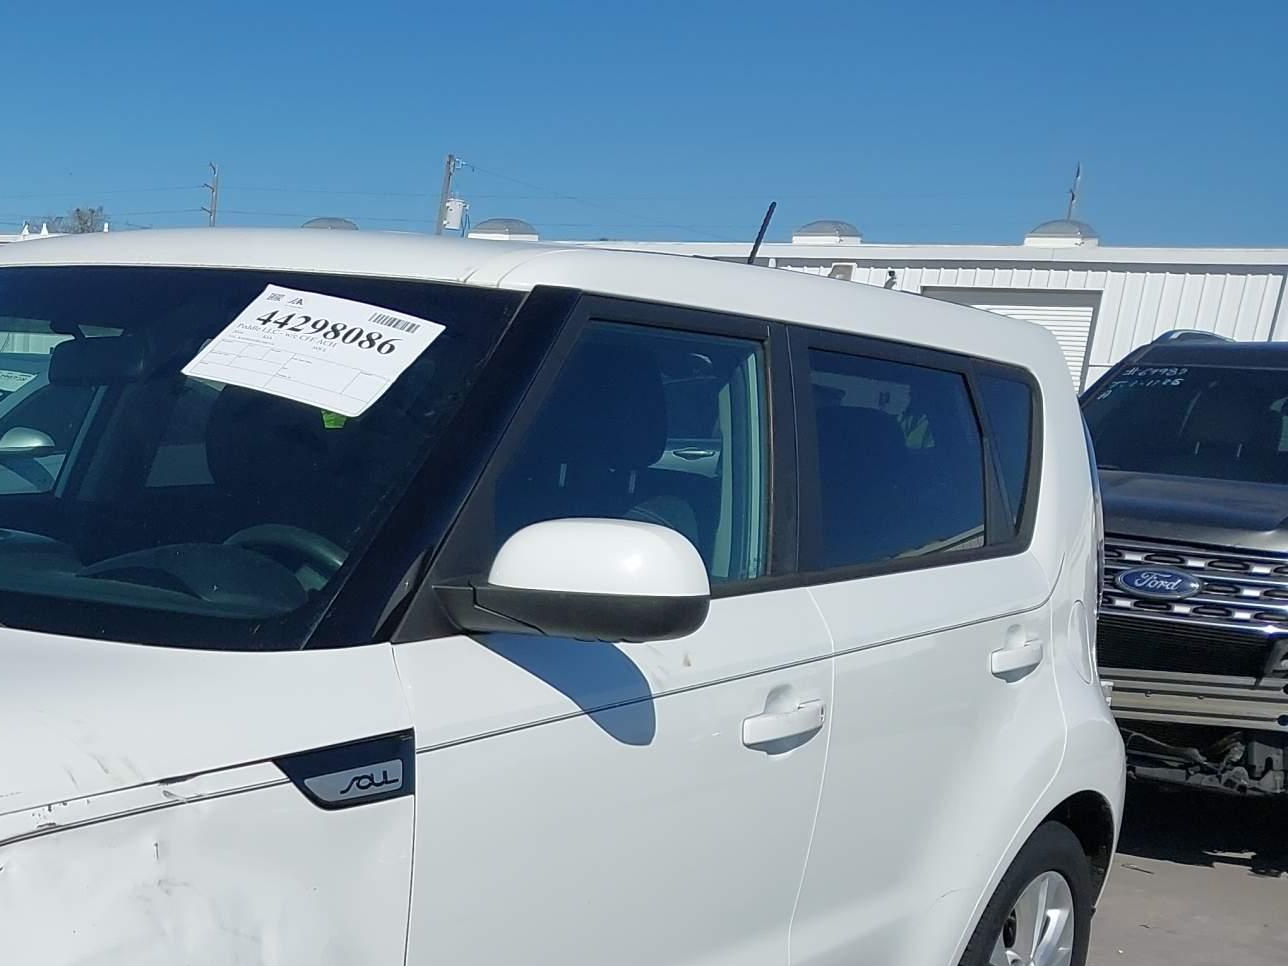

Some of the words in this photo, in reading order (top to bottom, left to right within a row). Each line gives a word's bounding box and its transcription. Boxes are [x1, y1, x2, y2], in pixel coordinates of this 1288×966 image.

[256, 310, 403, 355] 44298086
[1134, 571, 1182, 590] Ford
[339, 769, 399, 795] SOUL
